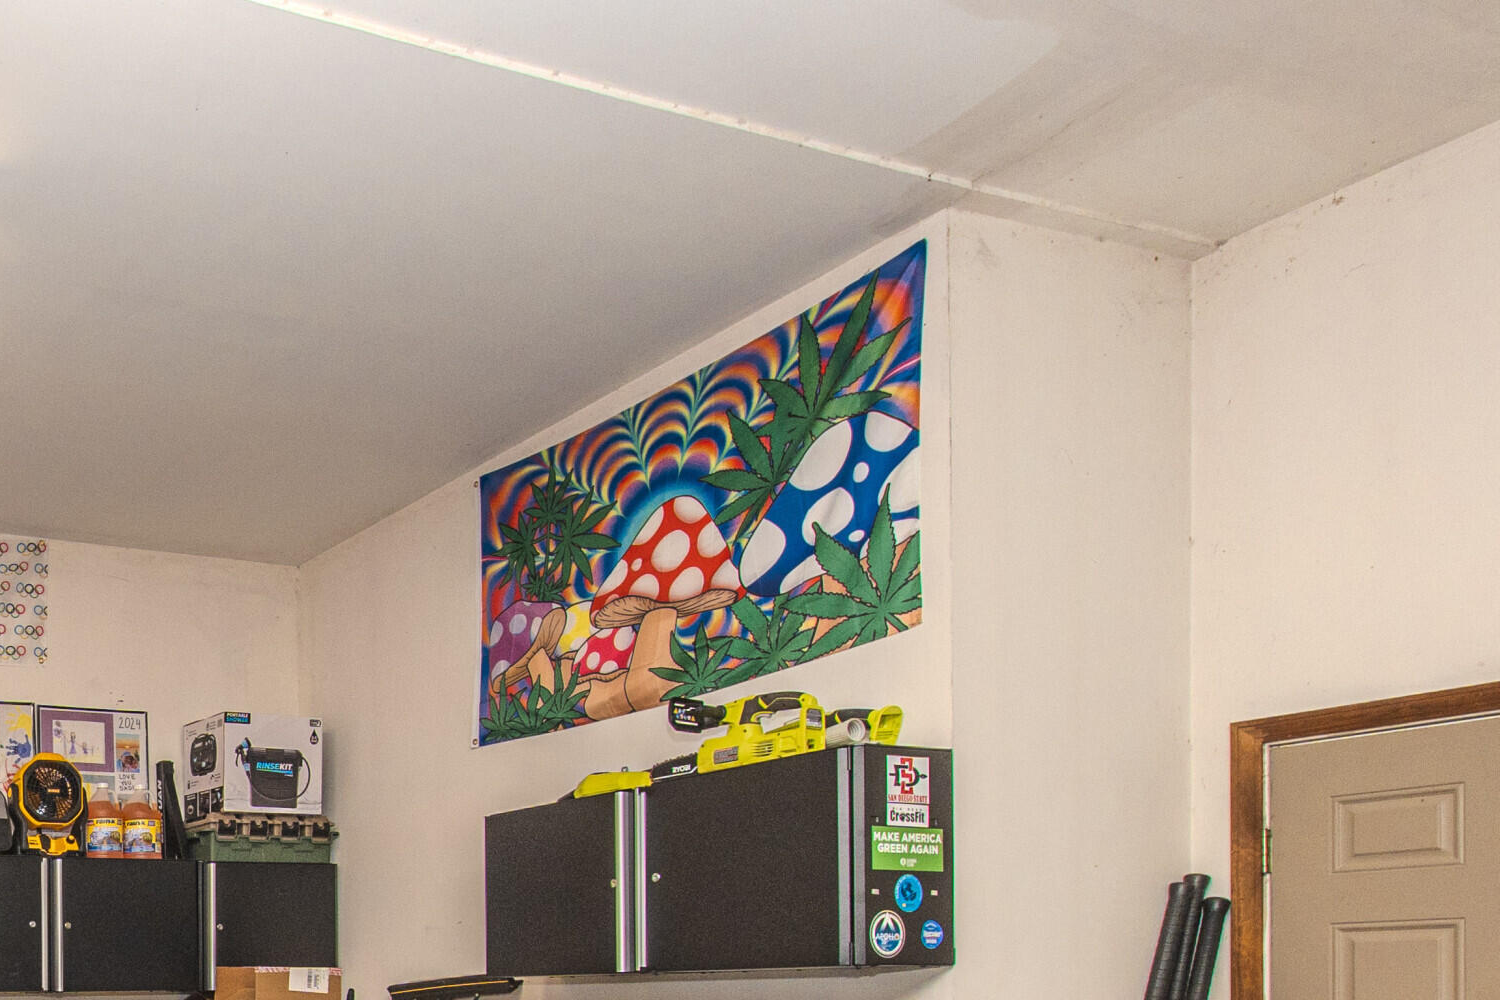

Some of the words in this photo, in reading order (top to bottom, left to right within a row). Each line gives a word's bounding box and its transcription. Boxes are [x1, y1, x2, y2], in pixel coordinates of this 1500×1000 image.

[119, 717, 141, 730] 2024
[256, 762, 293, 771] RINSEKIT
[672, 764, 691, 773] RYOBI
[898, 794, 913, 802] DIEGO
[890, 810, 924, 823] CrossFit
[873, 831, 900, 841] MAKE
[902, 832, 942, 844] AMERICA
[877, 843, 908, 854] GREEN
[910, 844, 939, 855] AGAIN
